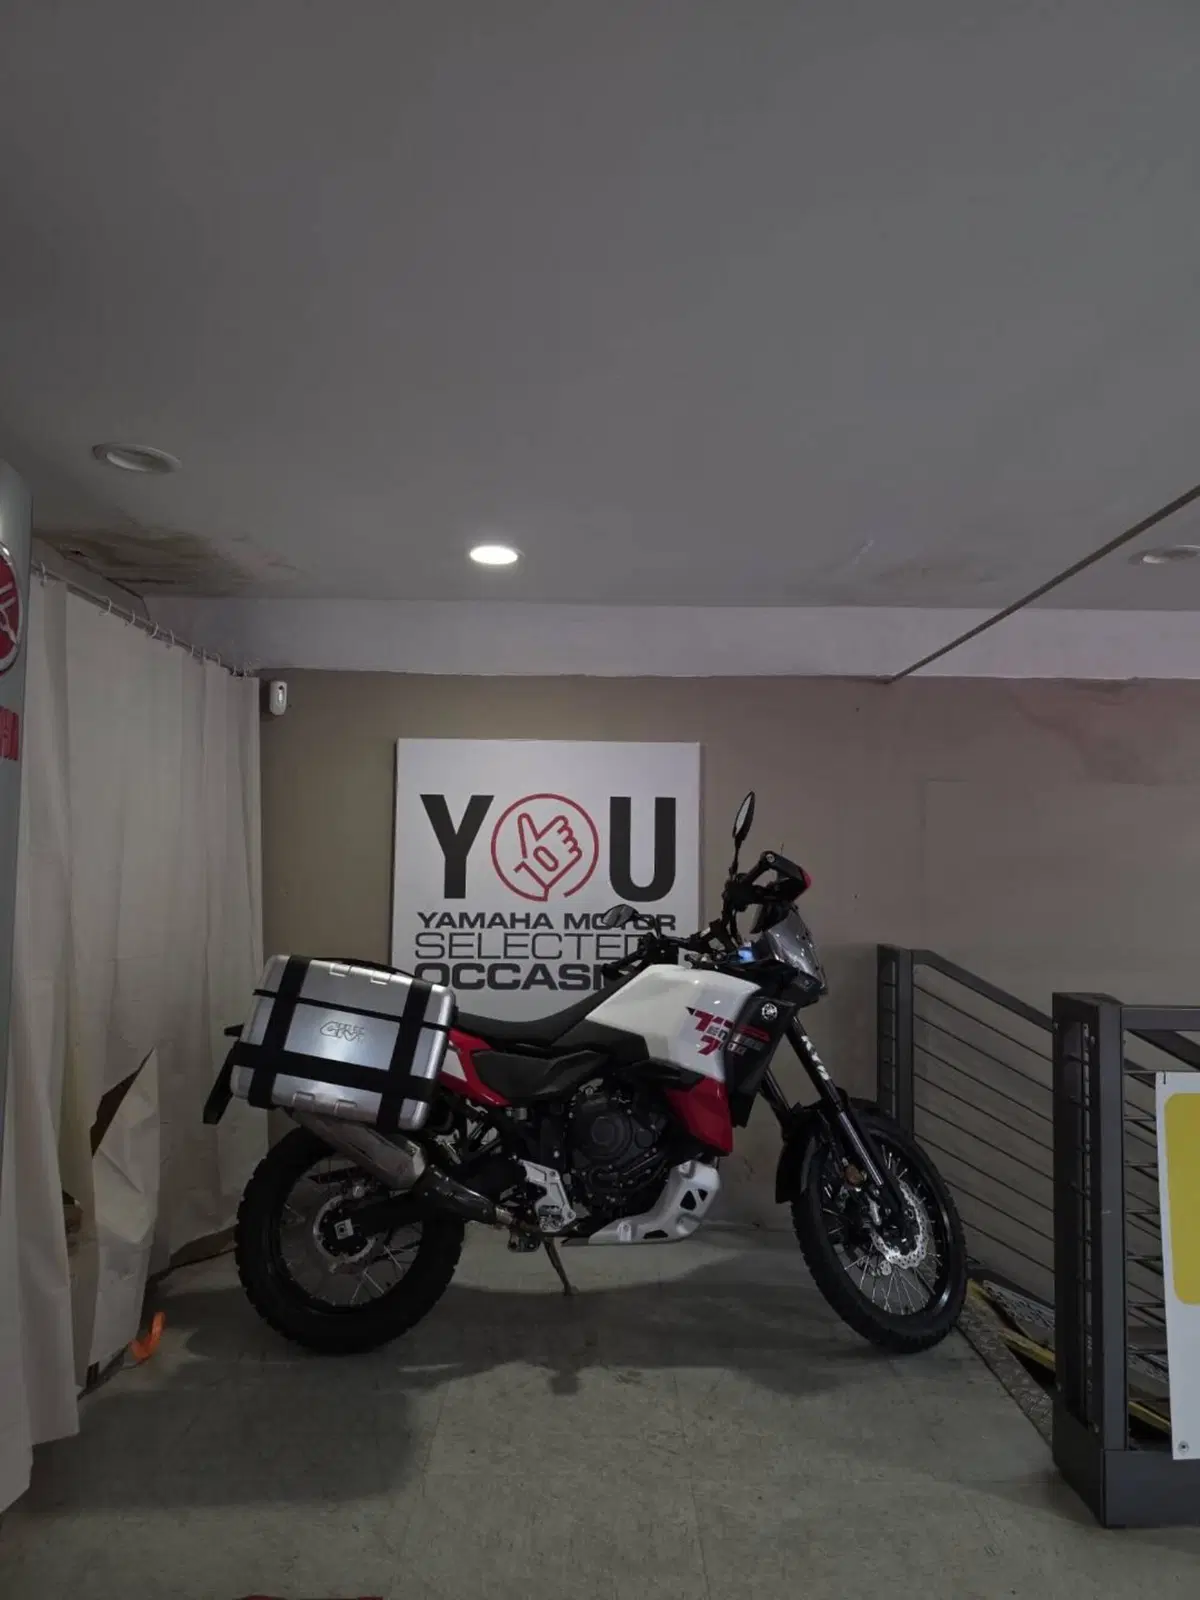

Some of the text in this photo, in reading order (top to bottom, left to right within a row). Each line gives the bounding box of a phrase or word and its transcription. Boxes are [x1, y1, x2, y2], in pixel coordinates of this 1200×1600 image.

[416, 911, 676, 931] YAMAHA MOOR
[413, 962, 604, 991] OCCASI
